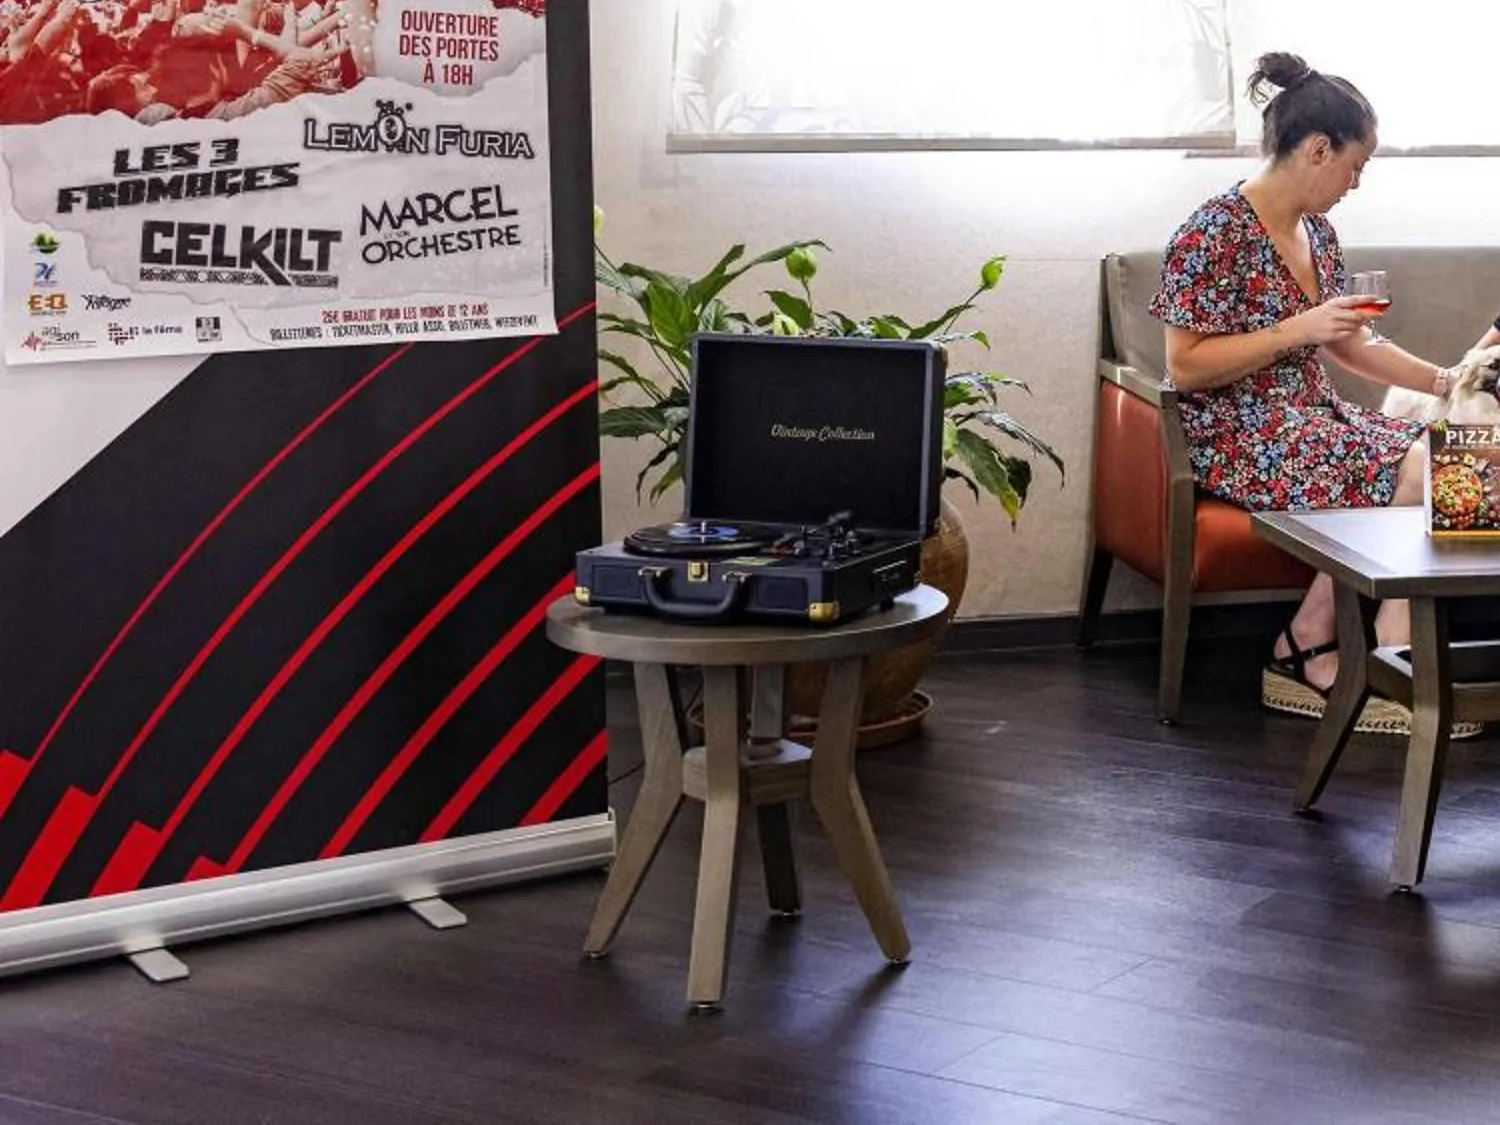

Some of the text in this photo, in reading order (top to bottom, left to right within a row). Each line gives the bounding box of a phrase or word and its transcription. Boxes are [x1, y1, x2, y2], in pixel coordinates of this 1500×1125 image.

[400, 10, 498, 38] OUVERTURE
[399, 34, 499, 61] DES PORTES
[424, 59, 473, 86] À 18H
[113, 138, 239, 175] LES 3
[435, 126, 534, 160] FURIA
[57, 163, 299, 213] FROMAGES
[360, 185, 518, 236] MARCEL
[140, 221, 343, 286] CELKILT
[361, 225, 522, 264] ORCHESTRE
[403, 306, 417, 320] LES
